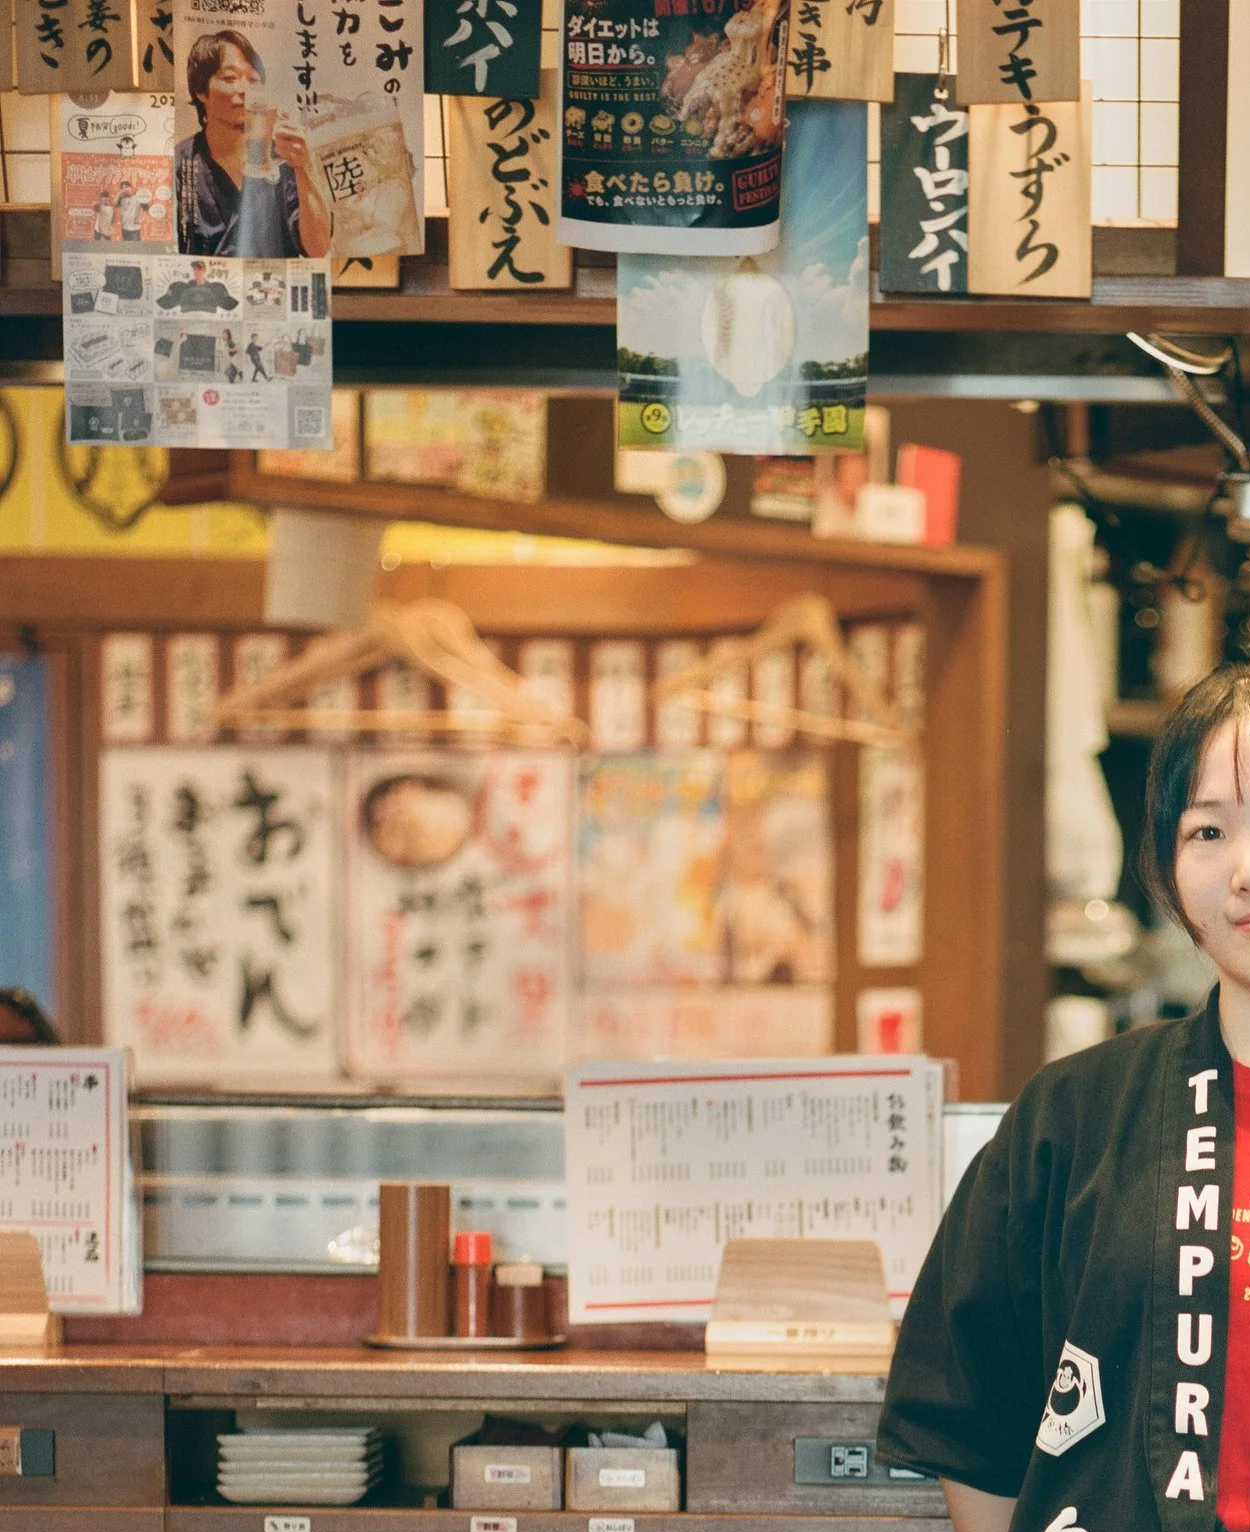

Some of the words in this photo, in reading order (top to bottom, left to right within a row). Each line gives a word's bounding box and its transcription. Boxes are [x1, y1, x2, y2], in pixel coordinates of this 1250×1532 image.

[332, 0, 361, 67] 力を
[567, 16, 660, 39] ダイエットは
[567, 42, 656, 65] 明日から。
[992, 0, 1043, 100] テキ
[323, 156, 365, 203] 陸
[479, 98, 552, 284] のどぶえ
[584, 170, 725, 193] 食べたら負け。
[586, 194, 723, 208] でも、食べないともっと負け。
[908, 104, 968, 292] ウーロンハイ
[1009, 105, 1071, 287] うずら
[235, 770, 320, 1045] おでん
[1165, 1069, 1220, 1501] TEMPURA
